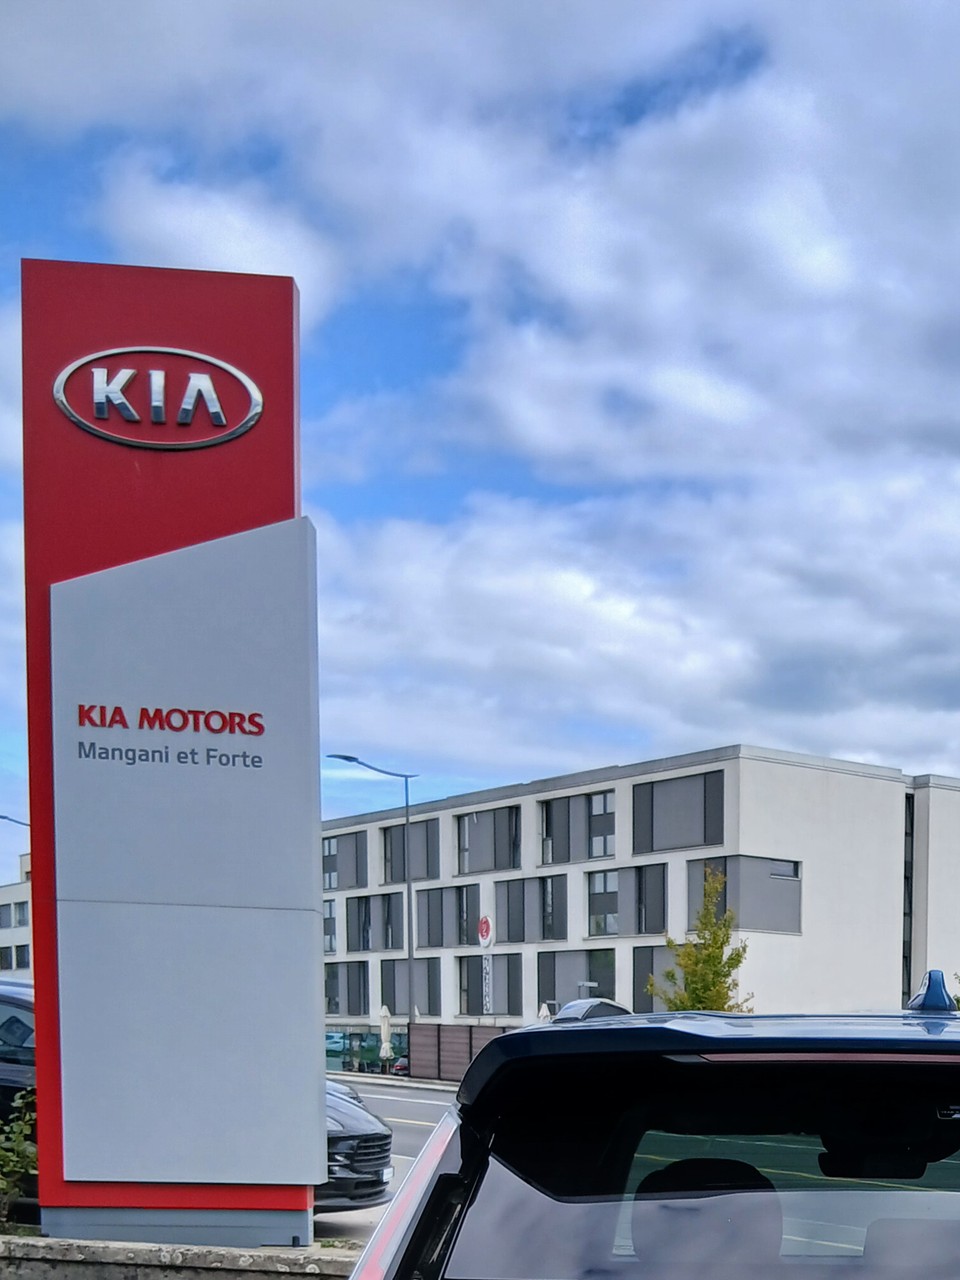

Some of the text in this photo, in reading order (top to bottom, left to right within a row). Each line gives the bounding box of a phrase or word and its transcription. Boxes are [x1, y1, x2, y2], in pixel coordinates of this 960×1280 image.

[91, 367, 227, 426] KIA
[78, 704, 266, 737] KIA MOTORS
[78, 741, 263, 768] Mangani et Forte
